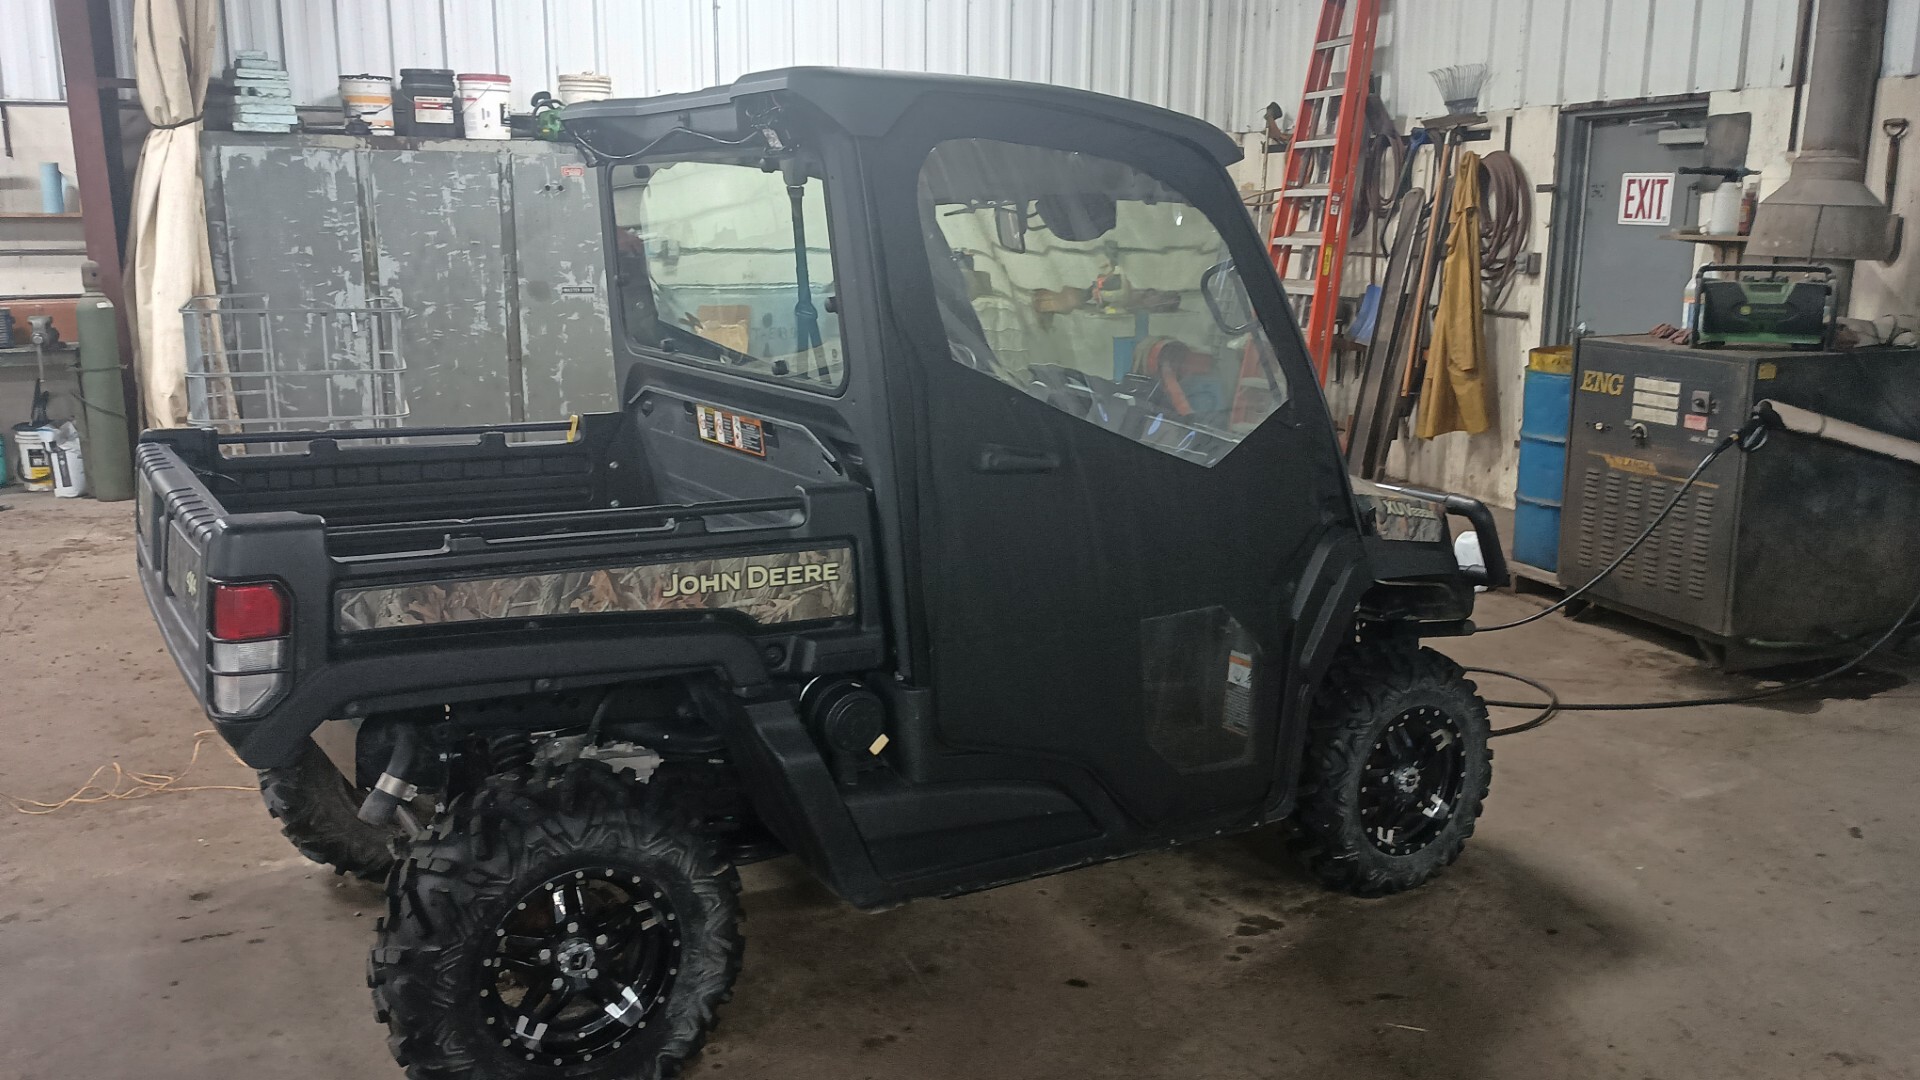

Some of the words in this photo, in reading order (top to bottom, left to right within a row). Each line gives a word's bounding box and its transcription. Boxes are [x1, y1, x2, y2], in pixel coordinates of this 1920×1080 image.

[1624, 179, 1669, 220] EXIT
[1580, 370, 1625, 396] ENG
[662, 571, 741, 598] JOHN
[747, 562, 840, 590] DEERE
